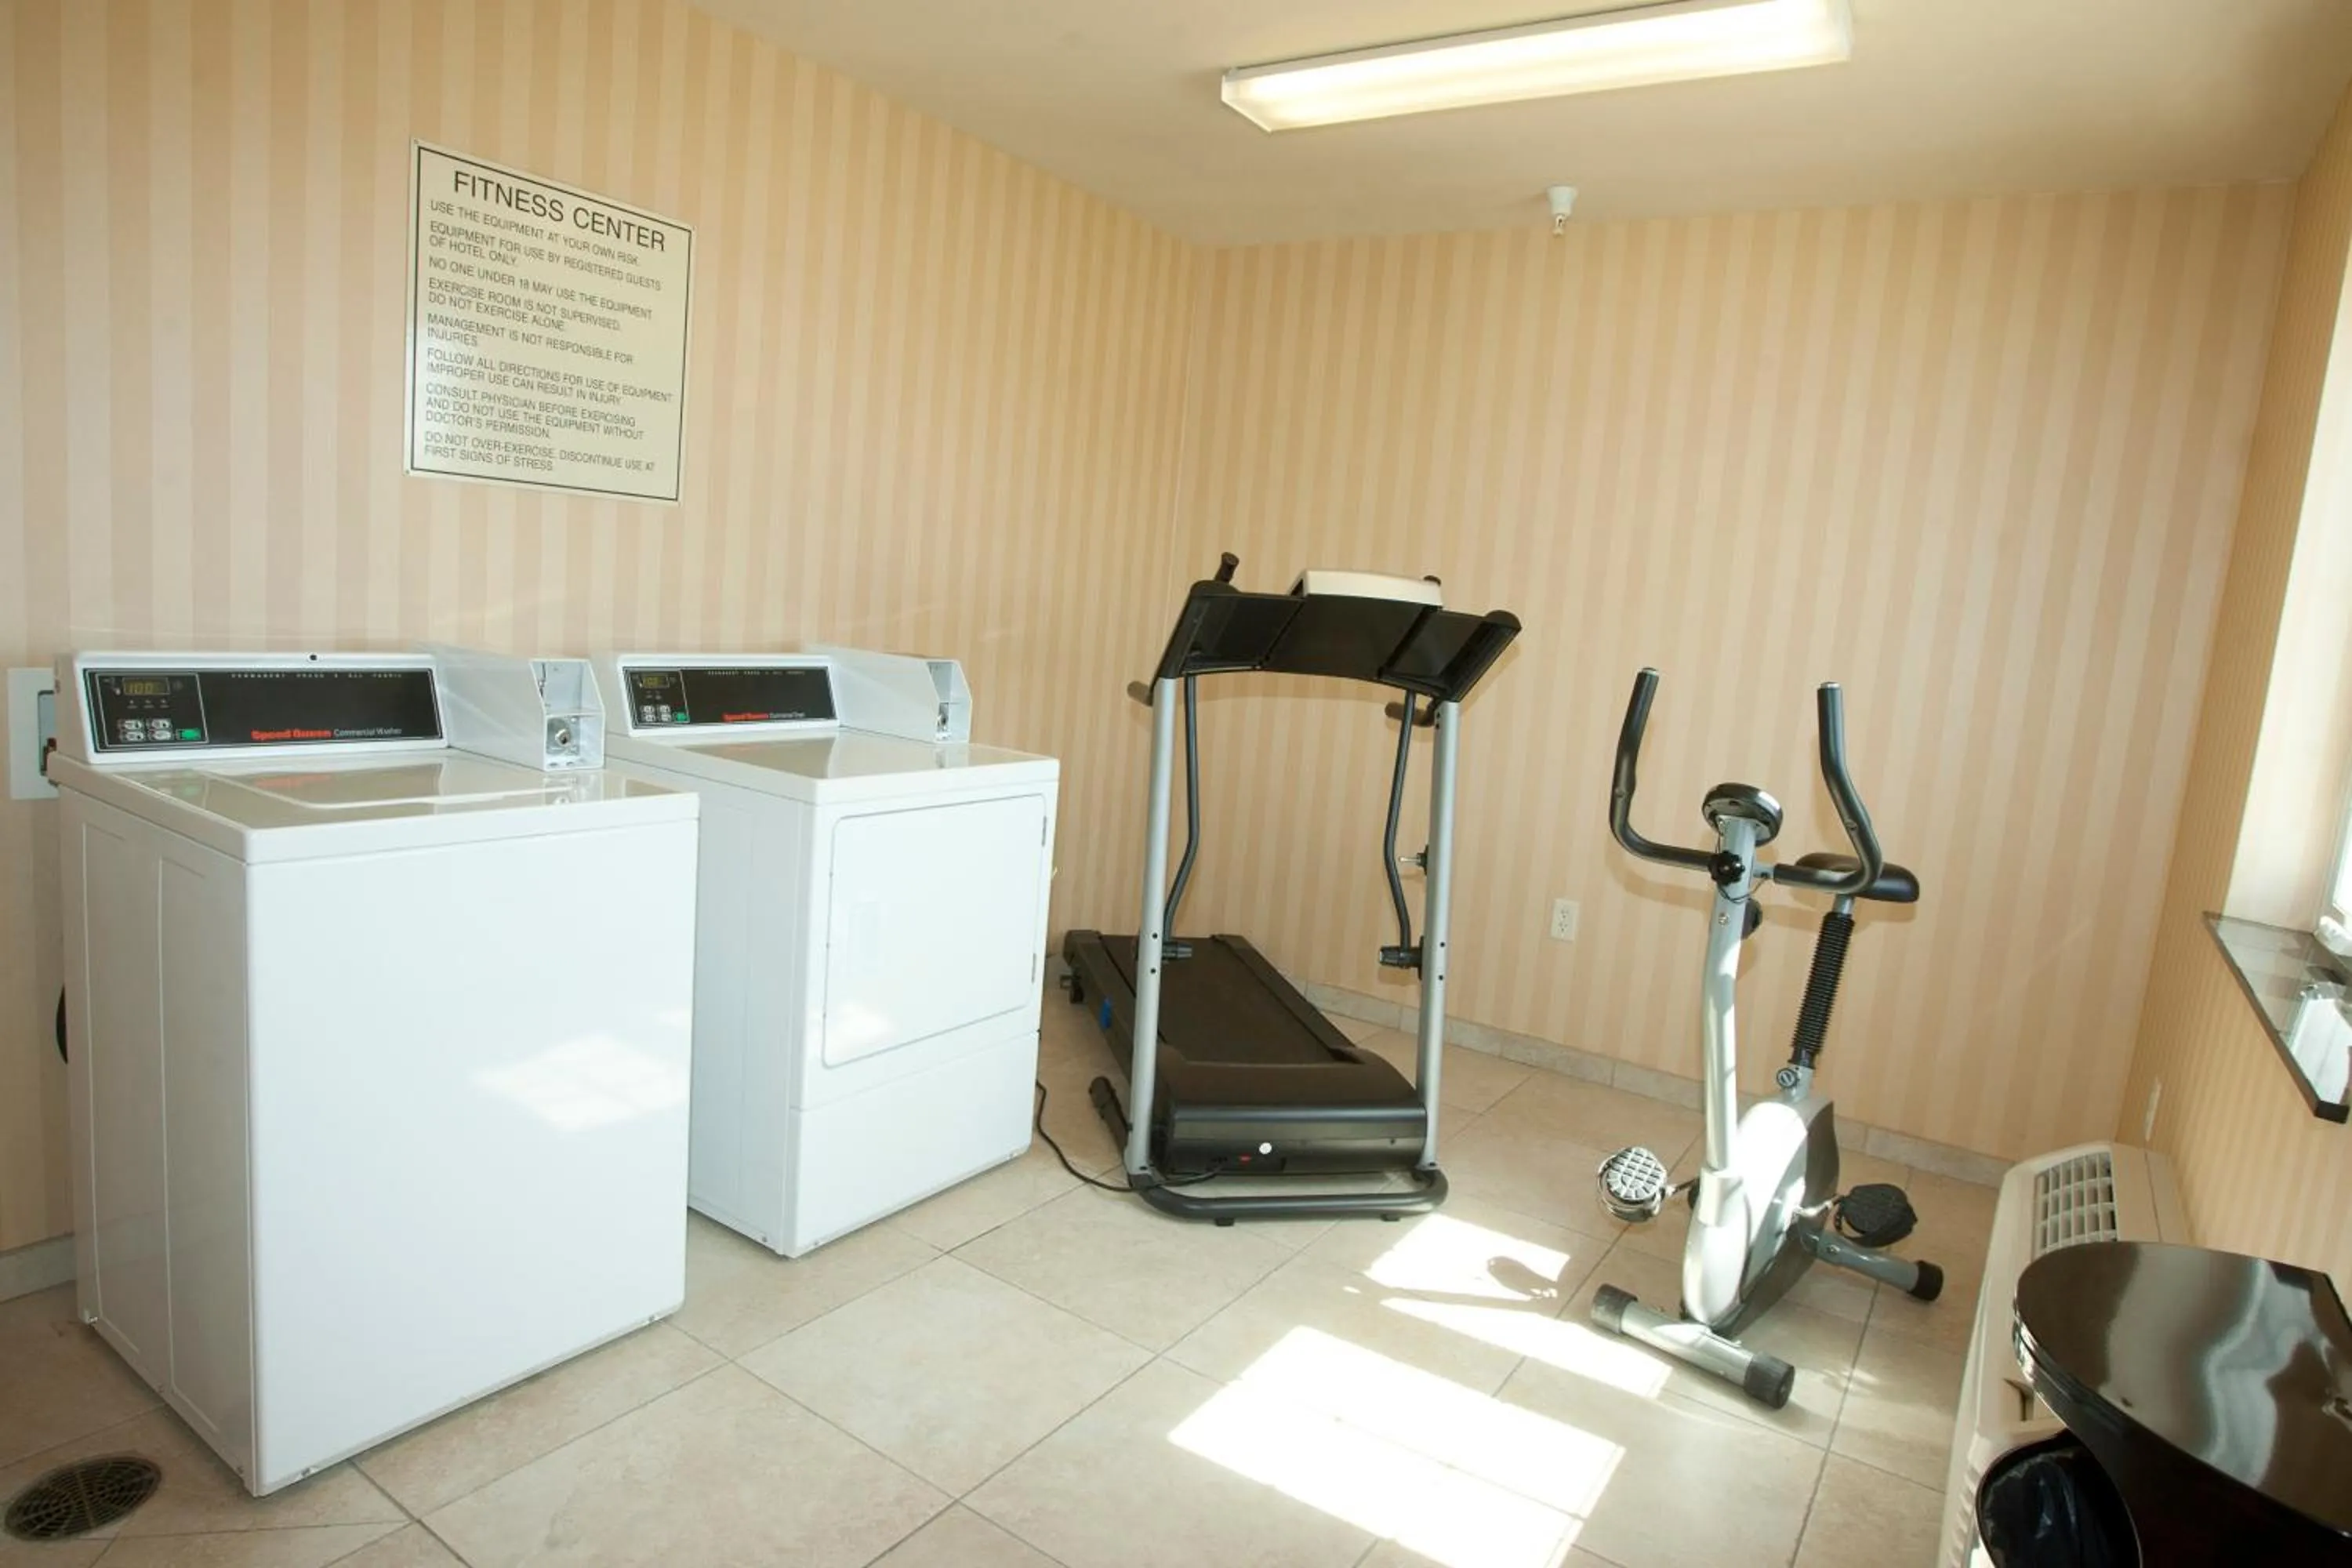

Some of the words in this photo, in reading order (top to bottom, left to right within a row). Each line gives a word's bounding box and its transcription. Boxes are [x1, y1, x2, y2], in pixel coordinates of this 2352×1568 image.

[430, 200, 455, 216] USE
[457, 206, 480, 223] THE
[483, 213, 544, 238] EQUIPMENT
[548, 231, 560, 244] AT
[563, 236, 590, 252] YOUR
[592, 243, 615, 260] OWN
[454, 170, 564, 222] FITNESS
[573, 206, 665, 252] CENTER
[429, 234, 446, 248] OF
[449, 239, 485, 258] HOTEL
[430, 220, 495, 247] EQUIPMENT
[499, 238, 521, 254] FOR
[524, 245, 545, 260] USE
[548, 251, 561, 263] BY
[564, 256, 623, 281] REGISTERED
[626, 272, 661, 291] GUESTS
[429, 256, 447, 270] NO
[450, 261, 474, 277] ONE
[477, 267, 515, 286] UNDER
[519, 278, 529, 290] 18
[532, 280, 553, 296] MAY
[556, 288, 576, 301] USE
[579, 292, 599, 307] THE
[600, 297, 652, 320] EQUIPMENT
[429, 277, 485, 299] EXERCISE
[488, 291, 521, 308] ROOM
[524, 299, 534, 311] IS
[536, 302, 557, 315] NOT
[429, 291, 446, 305] DO
[449, 296, 474, 310] NOT
[476, 302, 528, 323] EXERCISE
[427, 313, 506, 338] MANAGEMENT
[510, 328, 518, 341] IS
[521, 332, 543, 346] NOT
[546, 336, 612, 361] RESPONSIBLE
[614, 350, 633, 365] FOR
[426, 362, 485, 381] IMPROPER
[488, 372, 510, 387] USE
[512, 376, 534, 390] CAN
[537, 381, 572, 399] RESULT
[576, 389, 586, 401] IN
[427, 347, 474, 365] FOLLOW
[477, 357, 496, 372] ALL
[499, 361, 561, 382] DIRECTIONS
[563, 372, 584, 386] FOR
[586, 377, 604, 390] USE
[607, 381, 619, 393] OF
[426, 382, 477, 401] CONSULT
[481, 391, 535, 410] PHYSICIAN
[539, 401, 578, 418] BEFORE
[581, 408, 636, 427] EXERCISING
[426, 397, 449, 410] AND
[452, 401, 470, 413] DO
[473, 403, 495, 417] NOT
[498, 407, 520, 421] USE
[523, 411, 543, 425] THE
[545, 415, 600, 434] EQUIPMENT
[603, 425, 644, 440] WITHOUT
[426, 410, 482, 429] DOCTOR'S
[424, 445, 457, 459] FIRST
[459, 449, 493, 464] SIGNS
[495, 453, 511, 466] OF
[425, 430, 443, 443] DO
[445, 432, 469, 447] NOT
[559, 449, 623, 469] DISCONTINUE
[626, 459, 642, 471] USE
